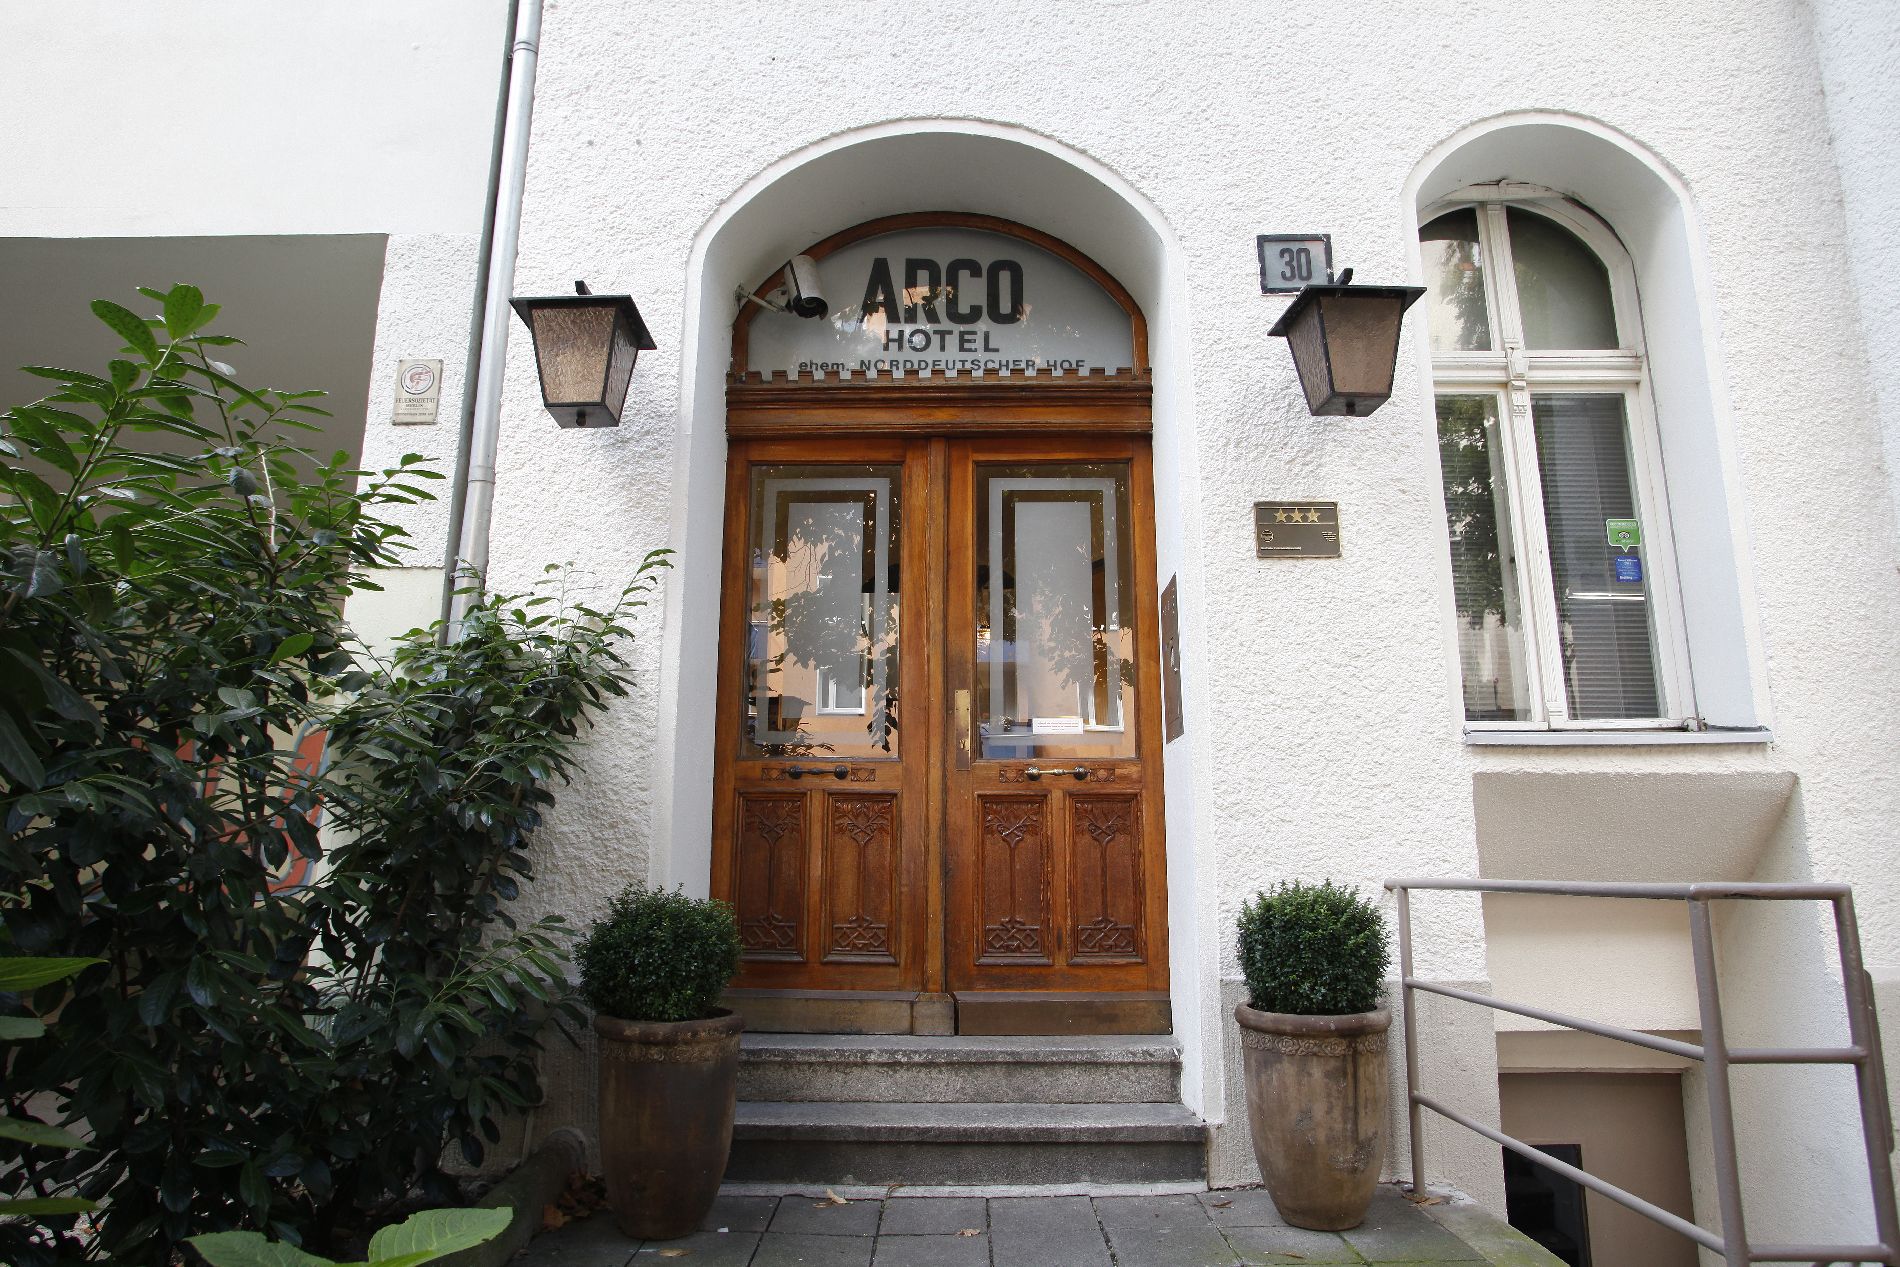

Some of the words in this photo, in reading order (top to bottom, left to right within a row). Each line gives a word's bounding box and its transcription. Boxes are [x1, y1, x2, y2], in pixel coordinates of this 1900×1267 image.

[1279, 247, 1312, 281] 30
[858, 257, 1023, 324] ARCO
[883, 328, 999, 353] HOTEL
[799, 359, 850, 372] ehem.
[1046, 359, 1086, 372] HOF
